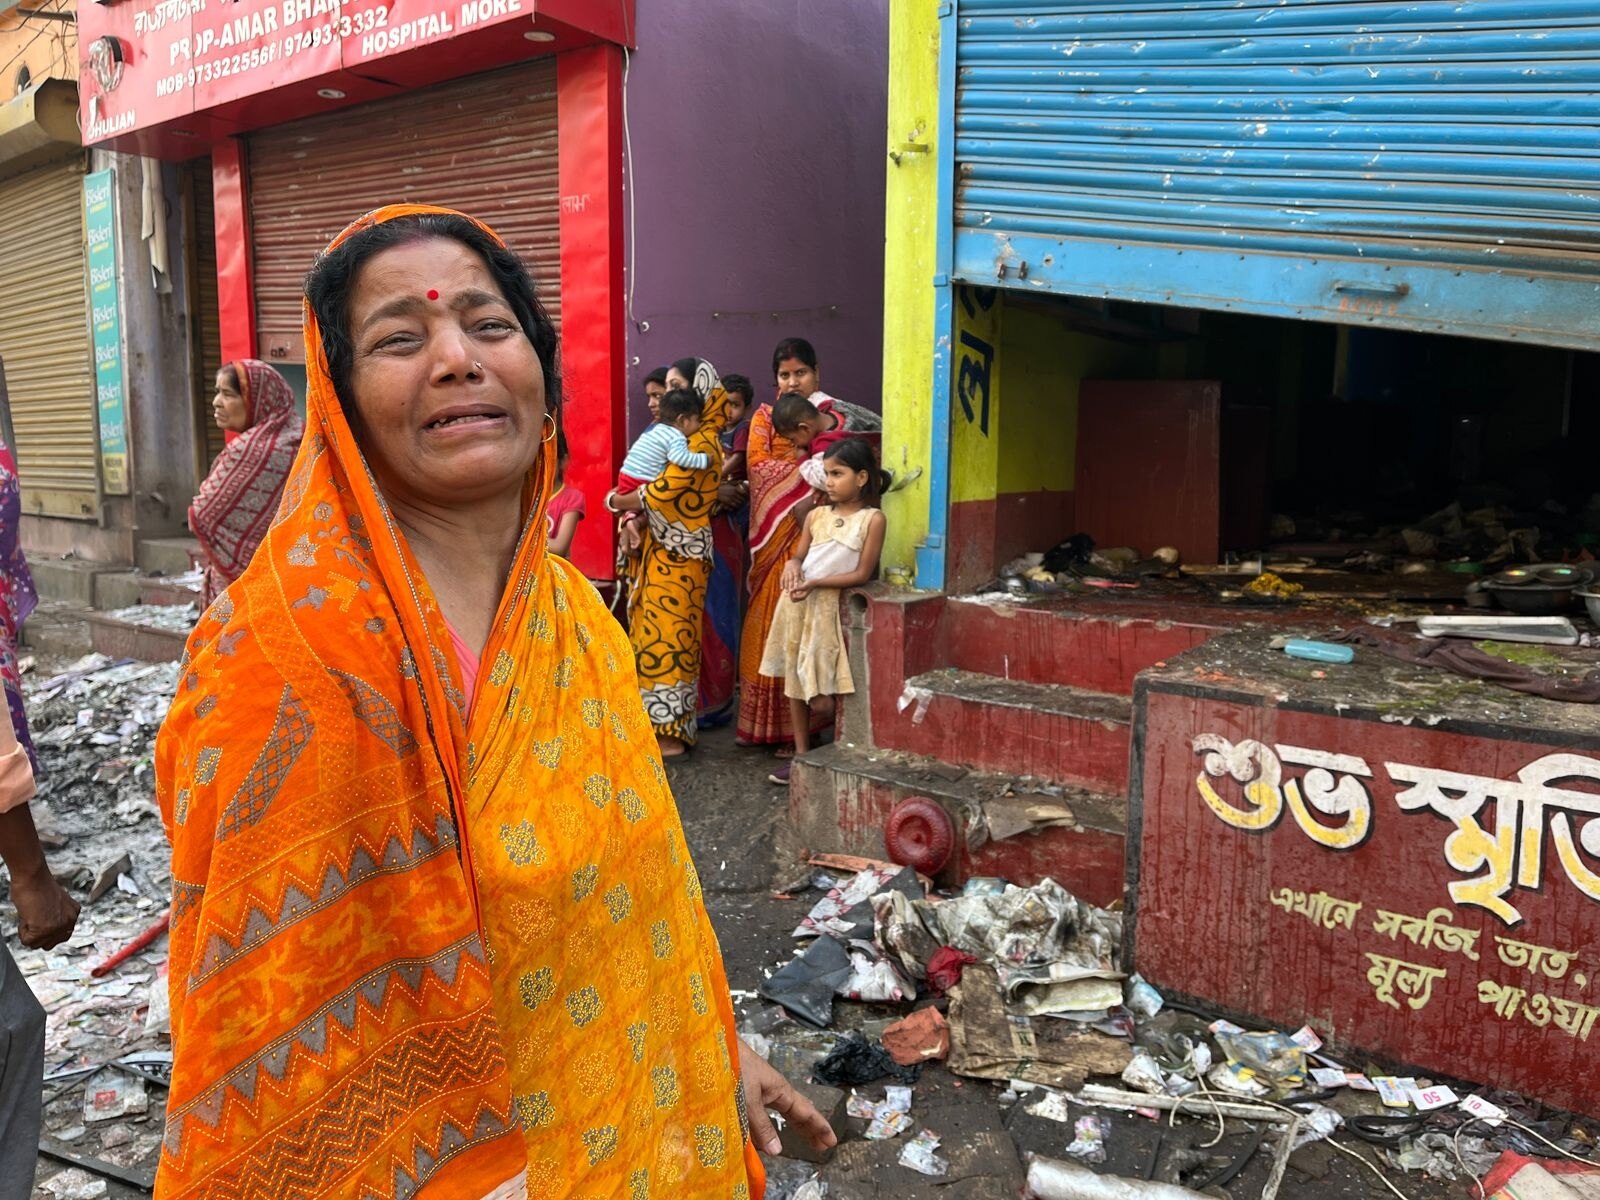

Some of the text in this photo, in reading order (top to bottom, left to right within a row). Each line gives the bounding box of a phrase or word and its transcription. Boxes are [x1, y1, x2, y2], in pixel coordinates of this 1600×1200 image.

[362, 0, 522, 56] HOSPITAL MORE
[85, 183, 111, 207] Bisleri
[87, 222, 112, 246] Bisleri
[90, 262, 115, 286] Bisleri
[93, 302, 117, 325] Bisleri
[95, 341, 119, 363] Bisleri
[97, 381, 121, 402] Bisleri
[1192, 733, 1373, 849] শুভ
[1270, 887, 1362, 930] এখানে
[1373, 907, 1481, 961] সবজি
[1365, 952, 1447, 1010] মূল্য
[1422, 1090, 1442, 1105] 50
